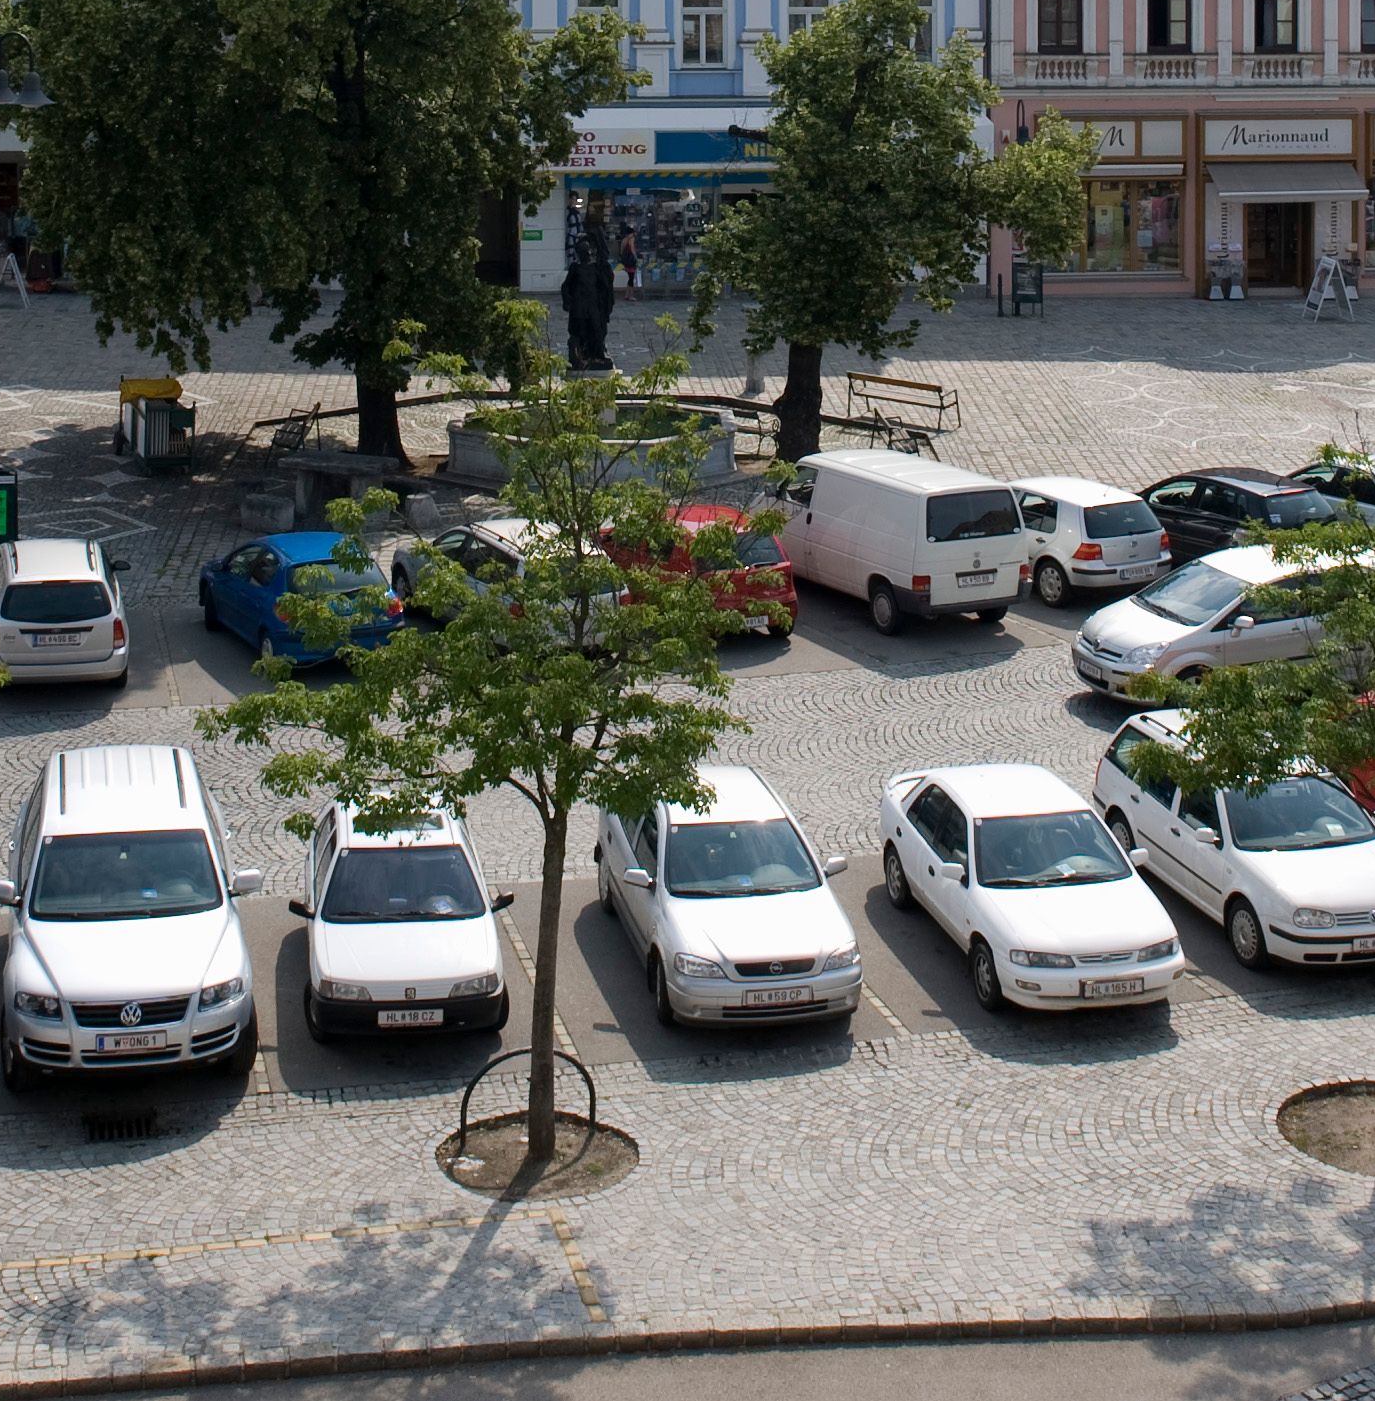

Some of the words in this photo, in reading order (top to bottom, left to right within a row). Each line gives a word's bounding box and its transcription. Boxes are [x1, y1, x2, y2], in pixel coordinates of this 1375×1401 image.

[1221, 124, 1329, 150] Marionnaud
[1091, 984, 1102, 994] HL
[1111, 983, 1127, 993] 165
[1129, 981, 1136, 991] H
[753, 993, 765, 1002] HL
[774, 991, 787, 1001] 59
[790, 990, 802, 1000] CP
[386, 1013, 399, 1023] HL
[421, 1011, 435, 1021] CZ
[114, 1037, 121, 1048] W
[129, 1036, 149, 1047] ONG
